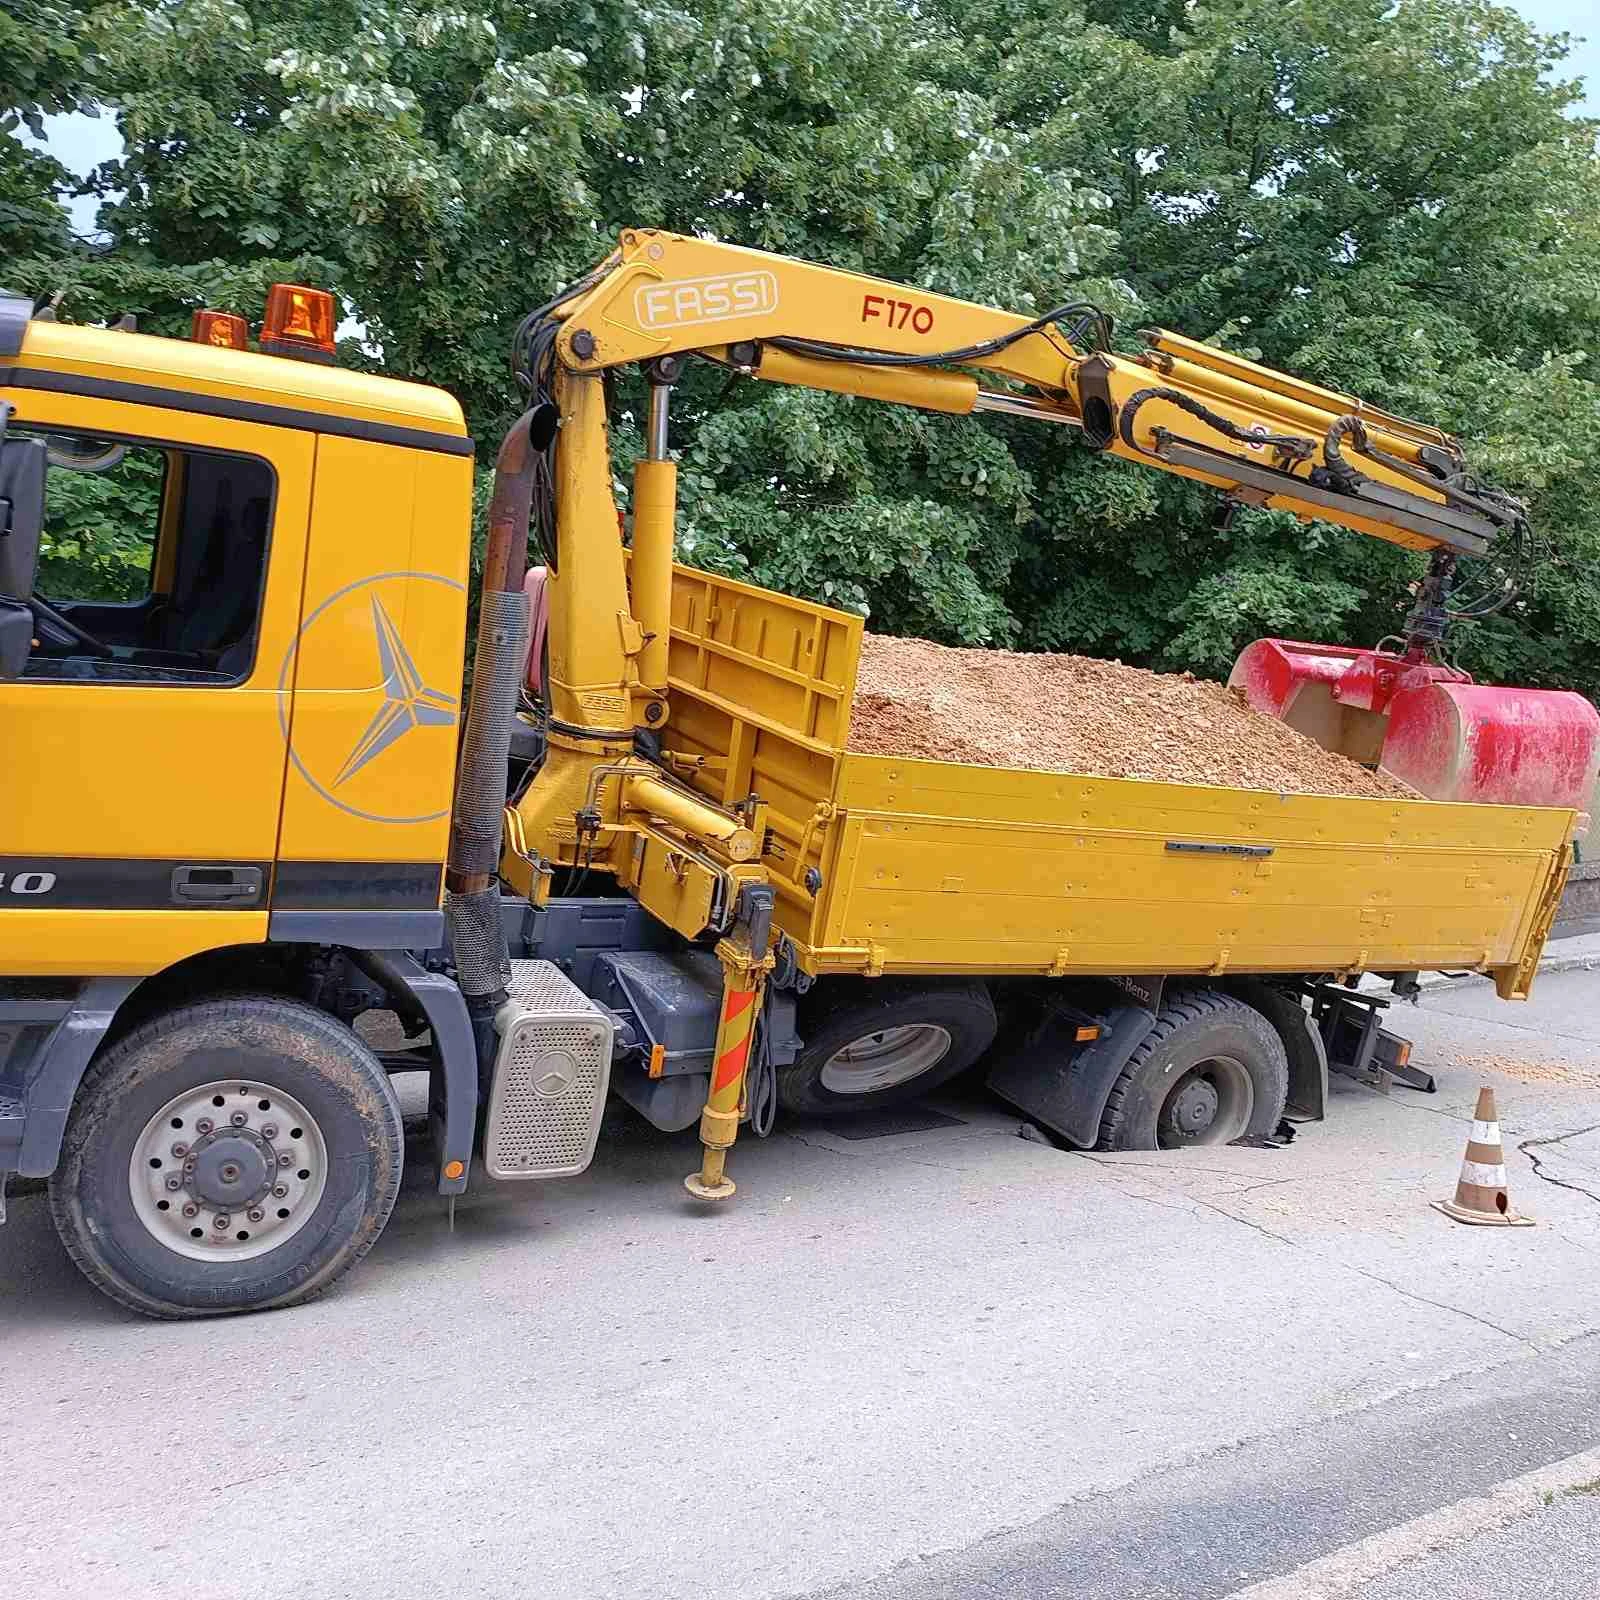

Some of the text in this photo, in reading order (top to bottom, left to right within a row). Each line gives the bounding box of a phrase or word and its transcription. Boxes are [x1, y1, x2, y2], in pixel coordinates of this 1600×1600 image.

[646, 278, 769, 322] FASSI
[862, 295, 934, 334] F170
[0, 872, 57, 894] 0
